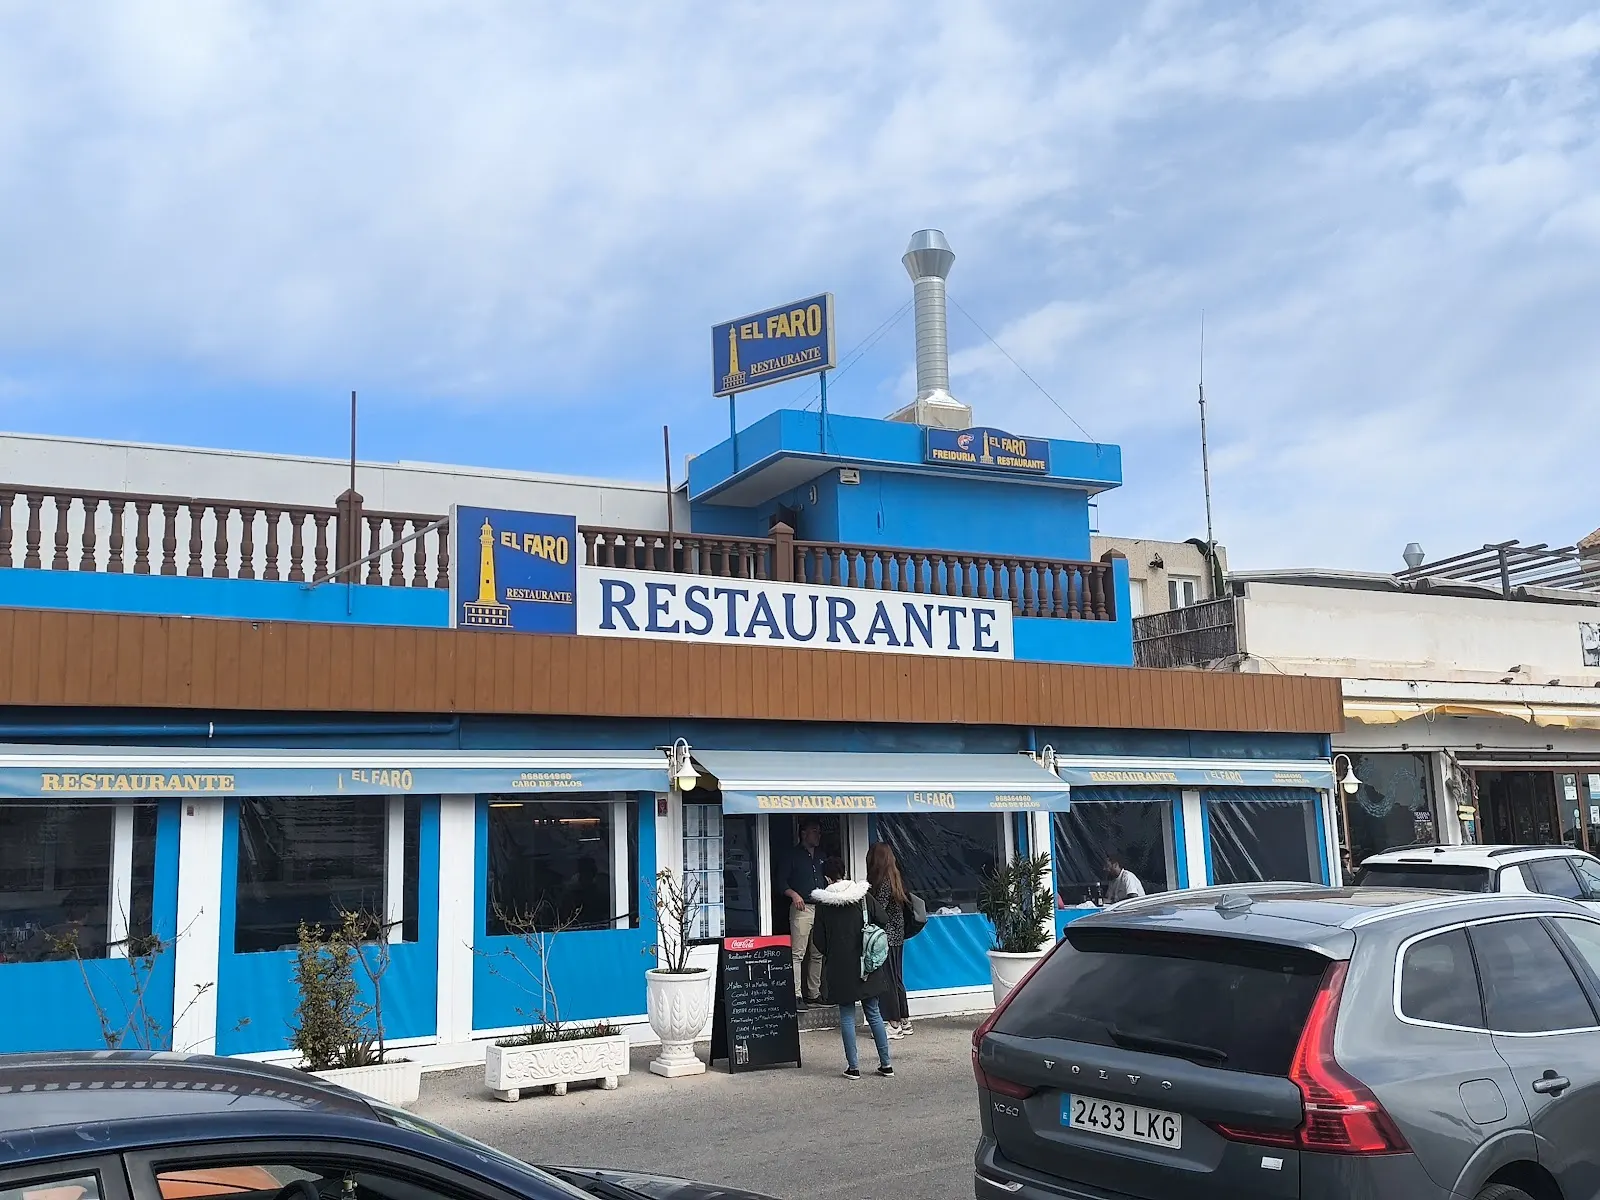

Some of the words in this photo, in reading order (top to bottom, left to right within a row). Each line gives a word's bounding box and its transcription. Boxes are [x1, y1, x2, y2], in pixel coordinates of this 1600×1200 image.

[740, 321, 764, 339] EL
[766, 303, 822, 338] FARO
[750, 346, 821, 375] RESTAURANTE
[932, 448, 976, 462] FREIDURIA
[989, 436, 1001, 448] EL
[1001, 437, 1026, 457] FARO
[996, 456, 1045, 469] RESTAURANTE
[500, 531, 521, 550] EL
[523, 533, 569, 565] FARO
[506, 587, 572, 602] RESTAURANTE
[599, 578, 1000, 653] RESTAURANTE
[40, 773, 235, 791] RESTAURANTE
[351, 769, 369, 783] EL
[370, 769, 413, 790] FARO
[511, 780, 537, 788] CABO
[538, 780, 552, 788] DE
[553, 780, 583, 788] PALOS
[1088, 771, 1178, 782] RESTAURANTE
[1210, 770, 1222, 779] EL
[1222, 770, 1244, 784] FARO
[756, 794, 877, 809] RESTAURANTE
[914, 792, 926, 803] EL
[926, 792, 956, 809] FARO
[731, 938, 755, 949] Coca-Cola
[1044, 1059, 1172, 1090] VOLVO
[994, 1101, 1020, 1117] XC60
[1062, 1111, 1069, 1121] E
[1074, 1099, 1126, 1132] 2433
[1133, 1109, 1176, 1142] LKG
